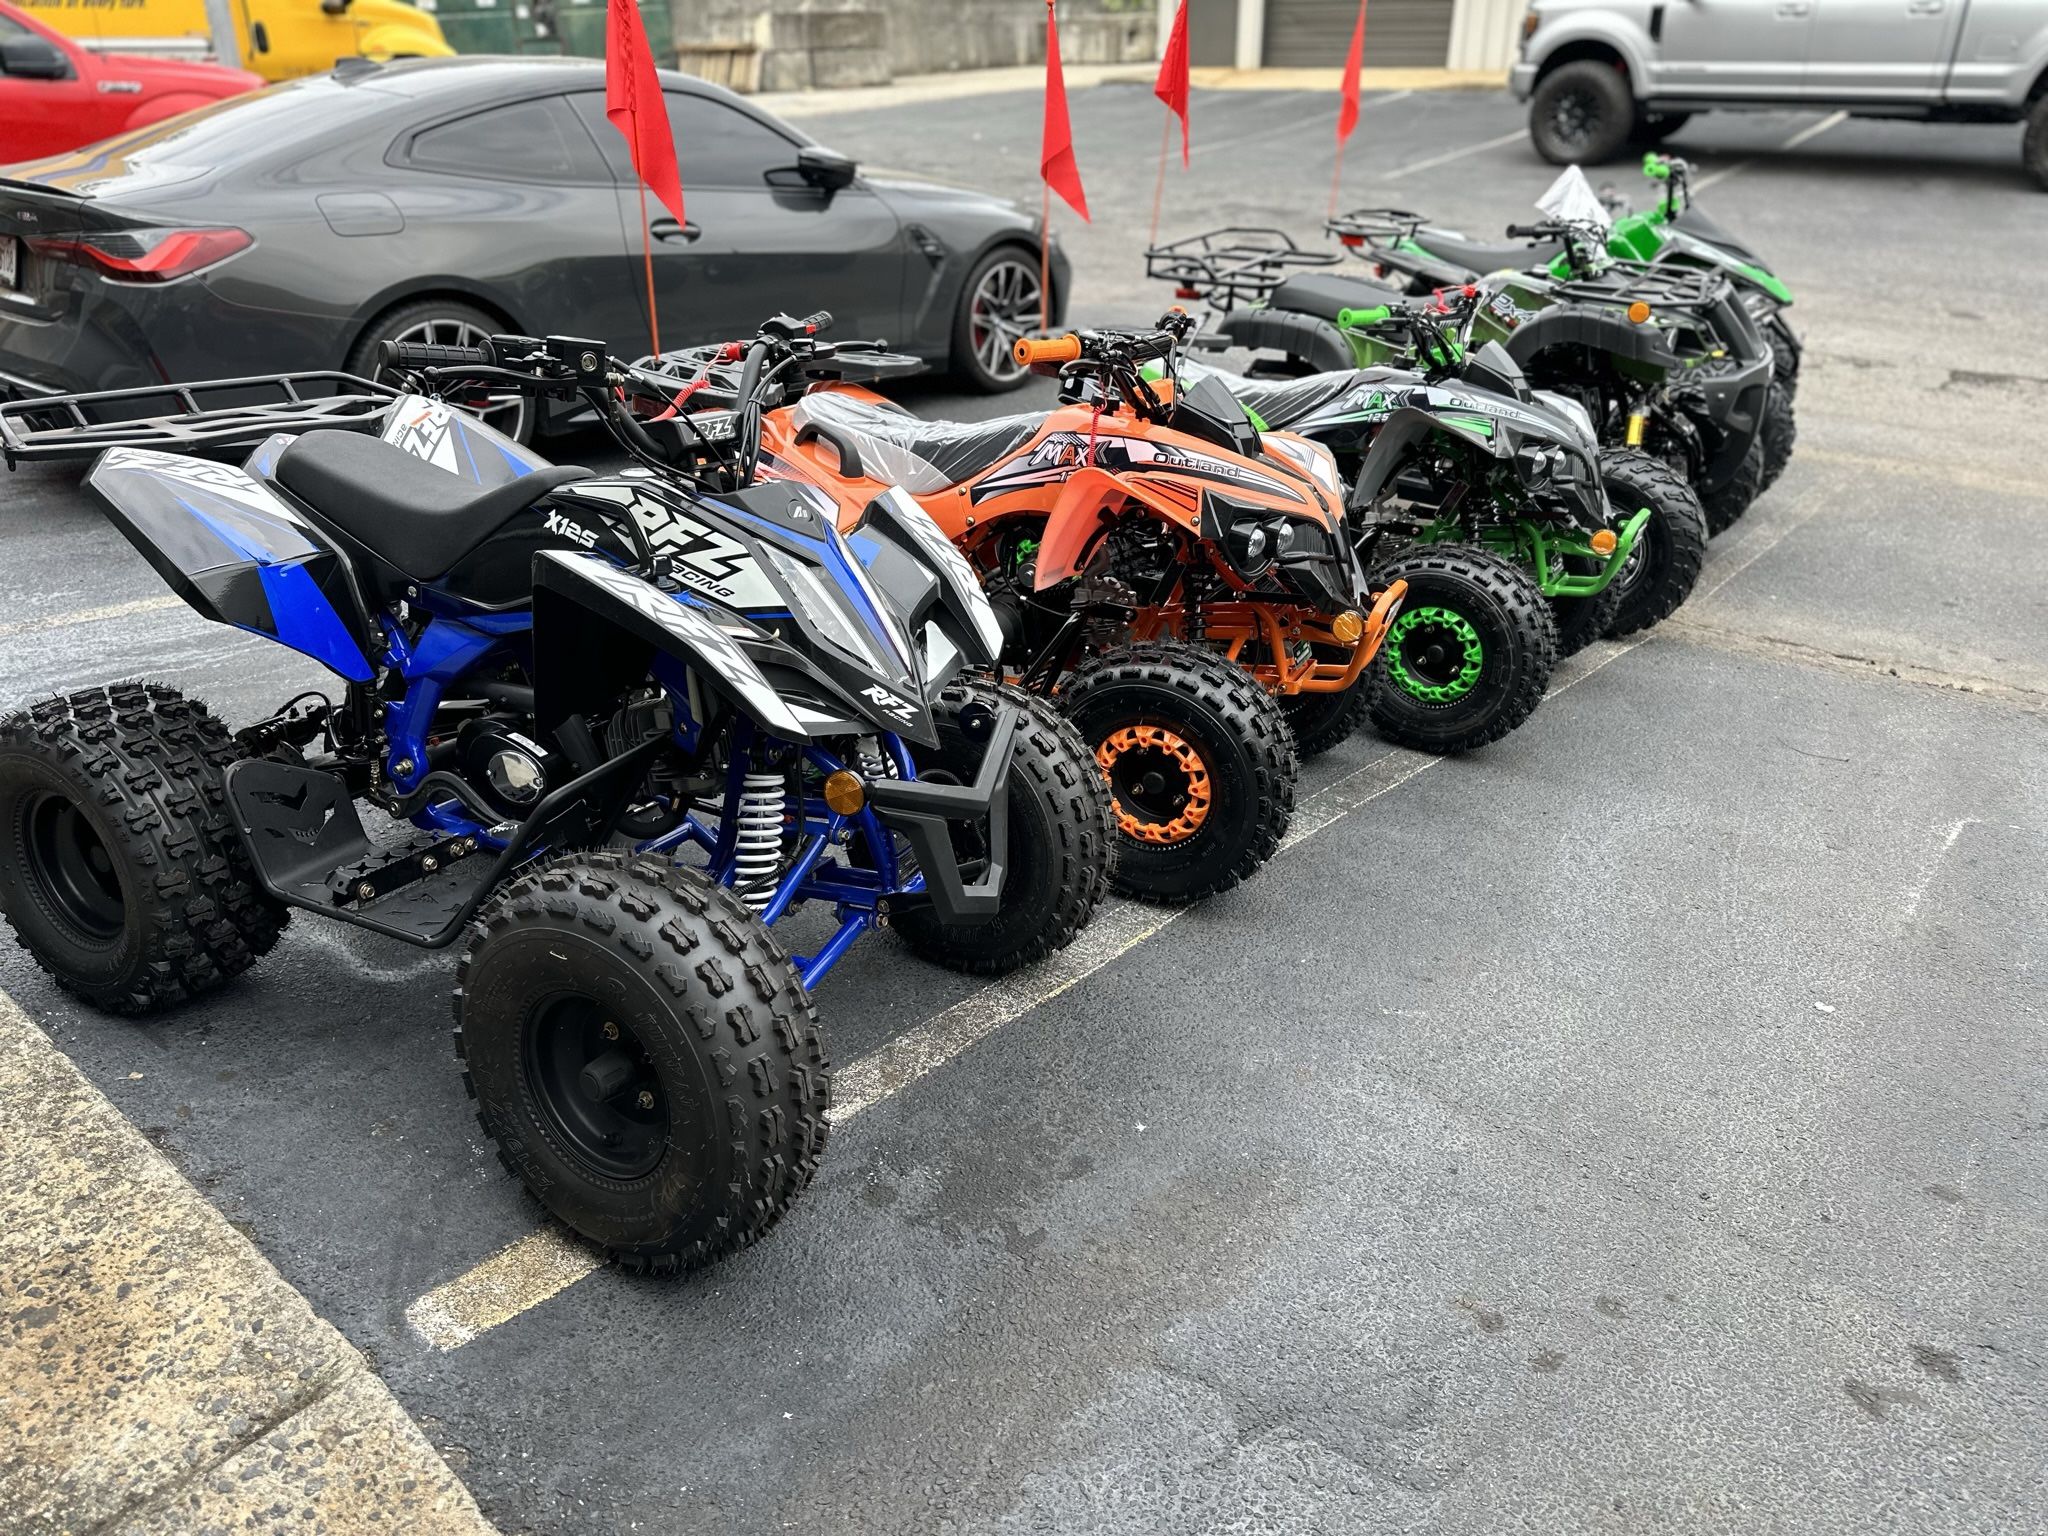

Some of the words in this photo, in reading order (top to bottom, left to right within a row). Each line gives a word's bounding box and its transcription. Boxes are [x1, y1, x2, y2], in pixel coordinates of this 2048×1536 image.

[1153, 452, 1241, 479] Outland
[543, 508, 599, 548] X125
[860, 683, 920, 720] RFZ
